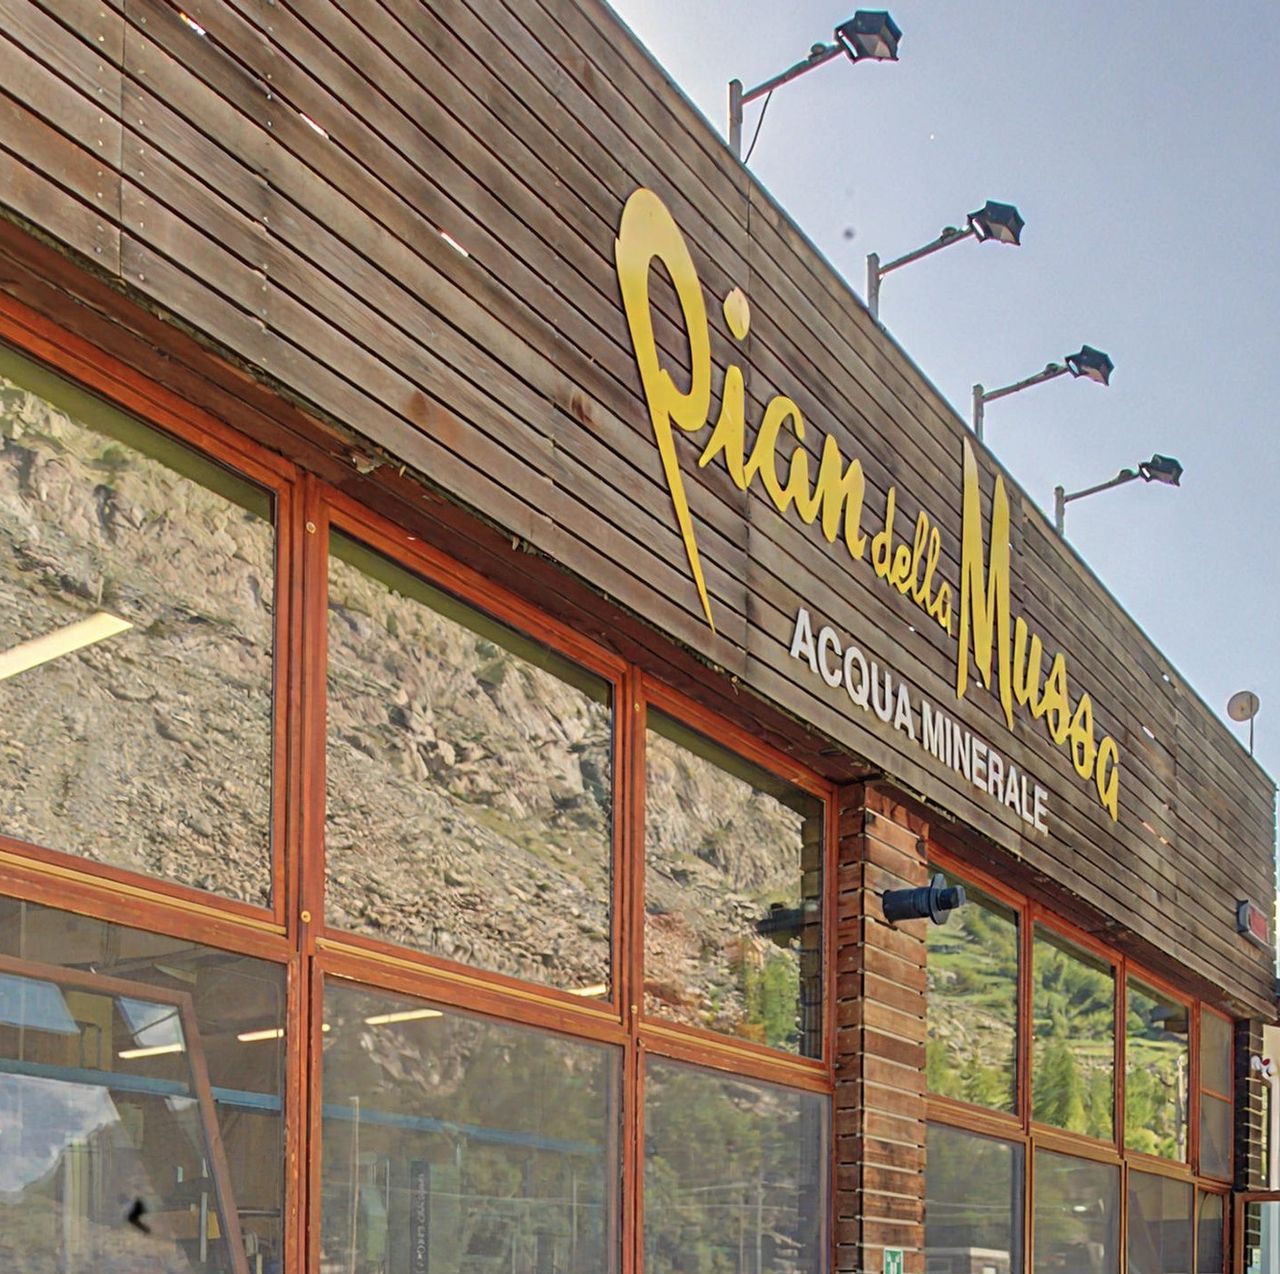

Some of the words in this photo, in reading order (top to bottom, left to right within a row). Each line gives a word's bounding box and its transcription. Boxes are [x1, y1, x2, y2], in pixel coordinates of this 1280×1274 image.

[616, 187, 866, 634] Pian
[871, 487, 952, 637] della
[957, 436, 1119, 822] Mussa
[790, 607, 916, 741] ACQUA
[922, 699, 1049, 837] MINERALE
